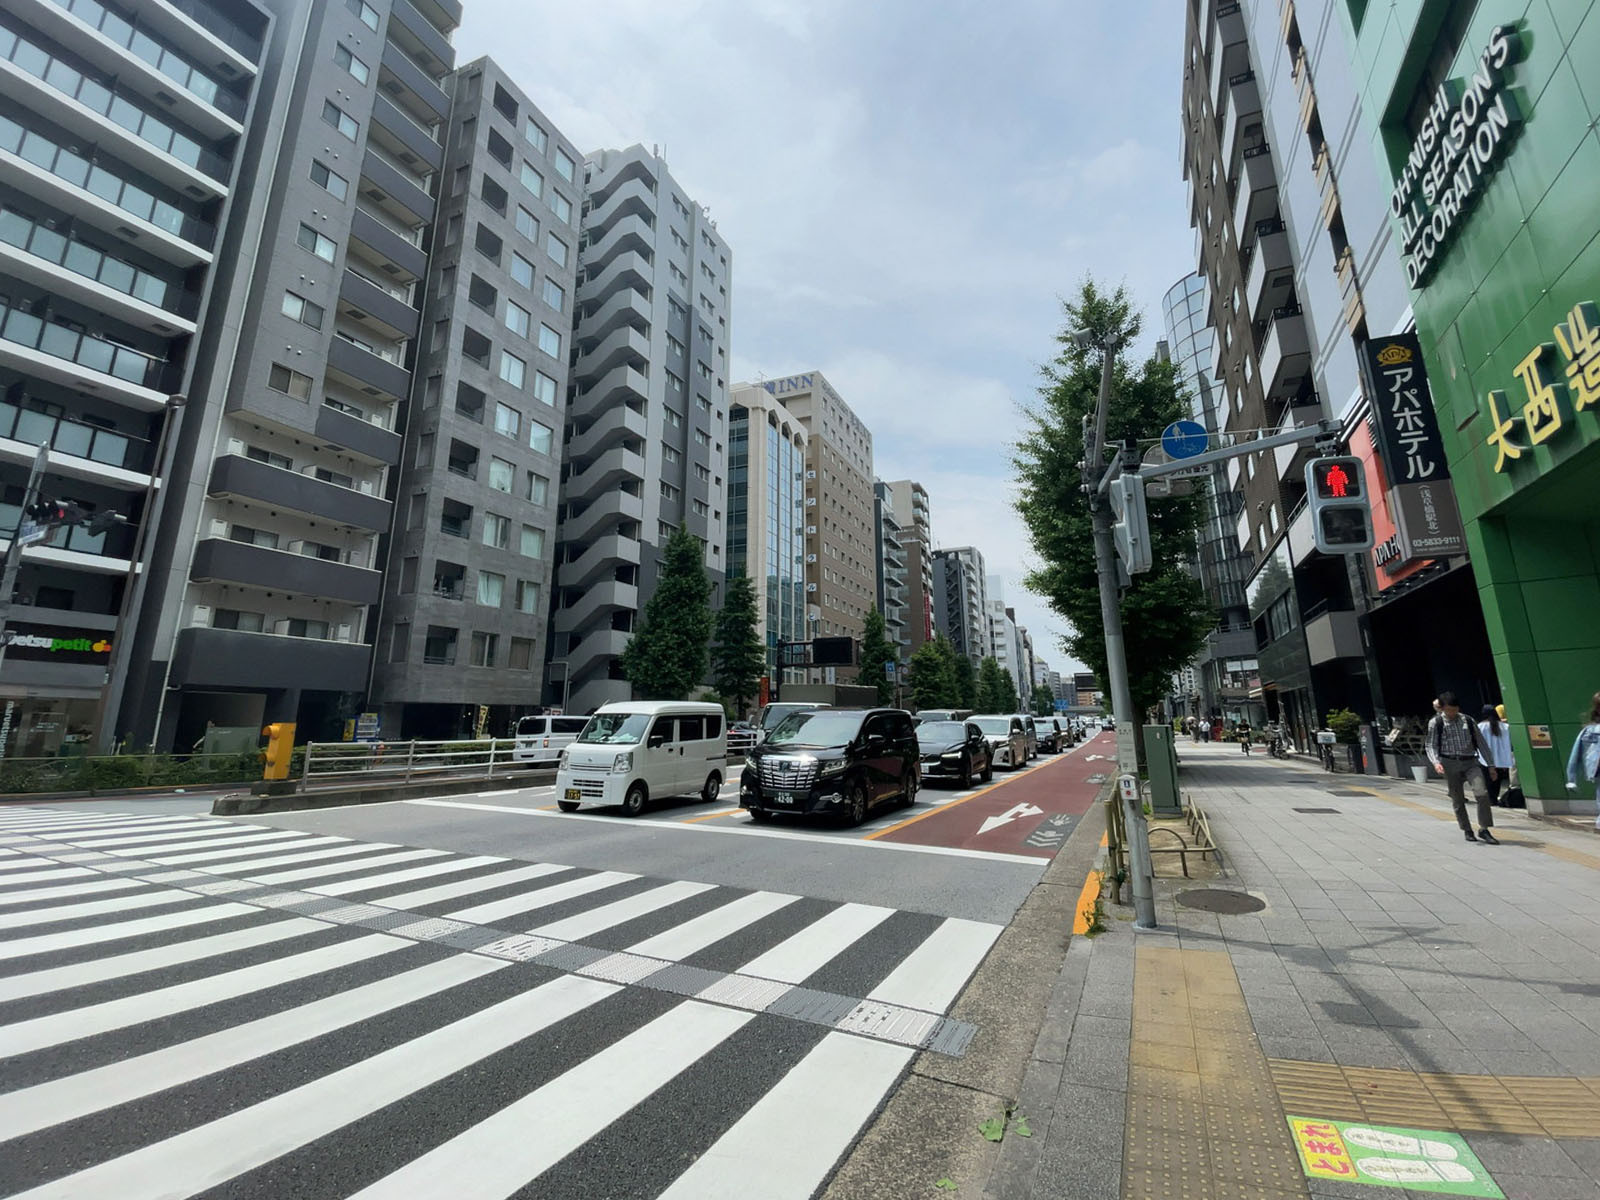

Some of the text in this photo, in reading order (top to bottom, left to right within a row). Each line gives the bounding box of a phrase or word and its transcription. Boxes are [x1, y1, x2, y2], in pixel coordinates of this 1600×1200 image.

[1390, 84, 1450, 218] OH-NISHI
[1399, 25, 1509, 252] ALL SEASON'S
[1406, 93, 1509, 290] DECORATION
[1384, 367, 1435, 479] アパホテル
[1300, 1123, 1350, 1175] とまれ
